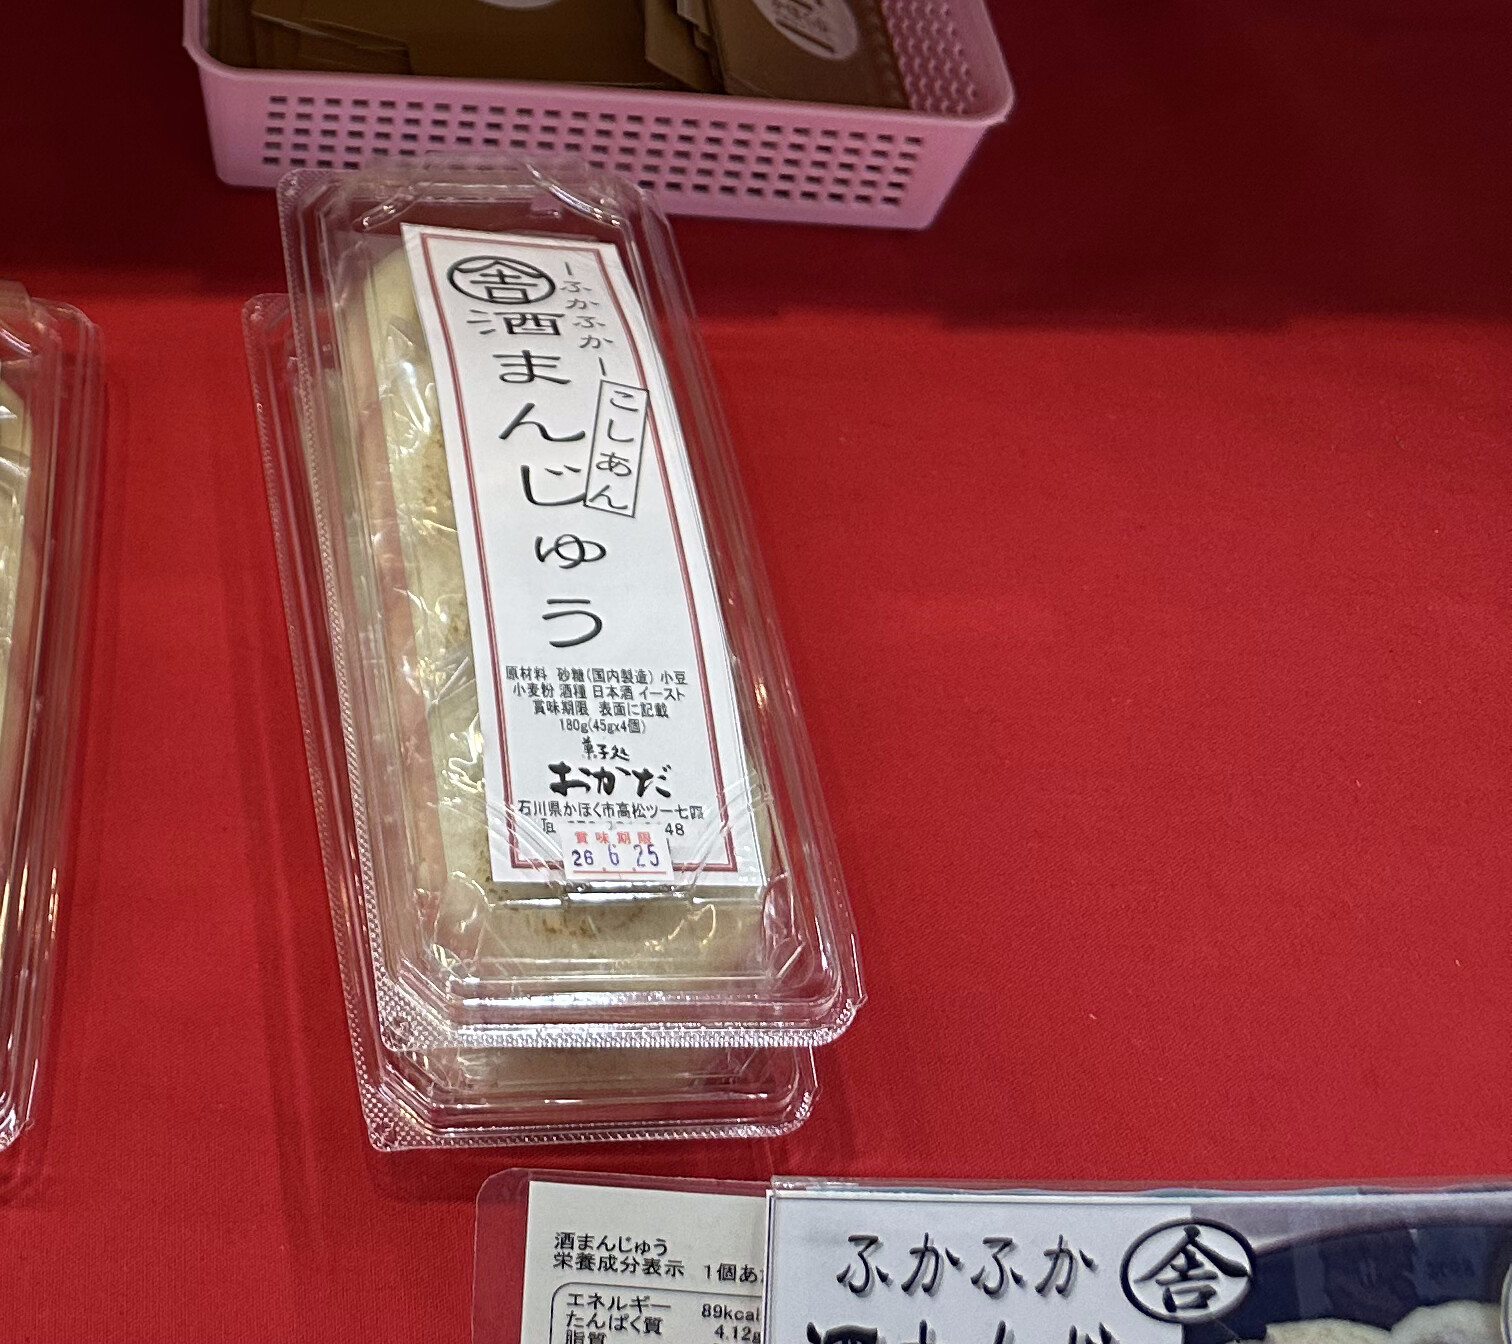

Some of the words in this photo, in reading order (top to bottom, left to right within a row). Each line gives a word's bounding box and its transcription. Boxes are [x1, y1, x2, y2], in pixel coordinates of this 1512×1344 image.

[588, 389, 640, 511] こしあん
[466, 308, 607, 648] 酒まんじゅう
[505, 665, 548, 682] 原材料
[660, 670, 688, 686] 小豆
[512, 682, 554, 698] 小麦粉
[592, 685, 635, 701] 日本酒
[638, 686, 686, 701] イースト
[532, 699, 589, 717] 賞味期限
[547, 761, 672, 798] おかだ
[571, 849, 594, 867] 26
[633, 843, 660, 868] 25
[553, 1231, 669, 1256] 酒まんじゅう
[552, 1251, 686, 1278] 栄養成分表示
[704, 1262, 764, 1284] 1個あ
[835, 1231, 1100, 1297] ふかふか
[566, 1292, 672, 1313] エネルギー
[565, 1310, 664, 1335] たんぱく質
